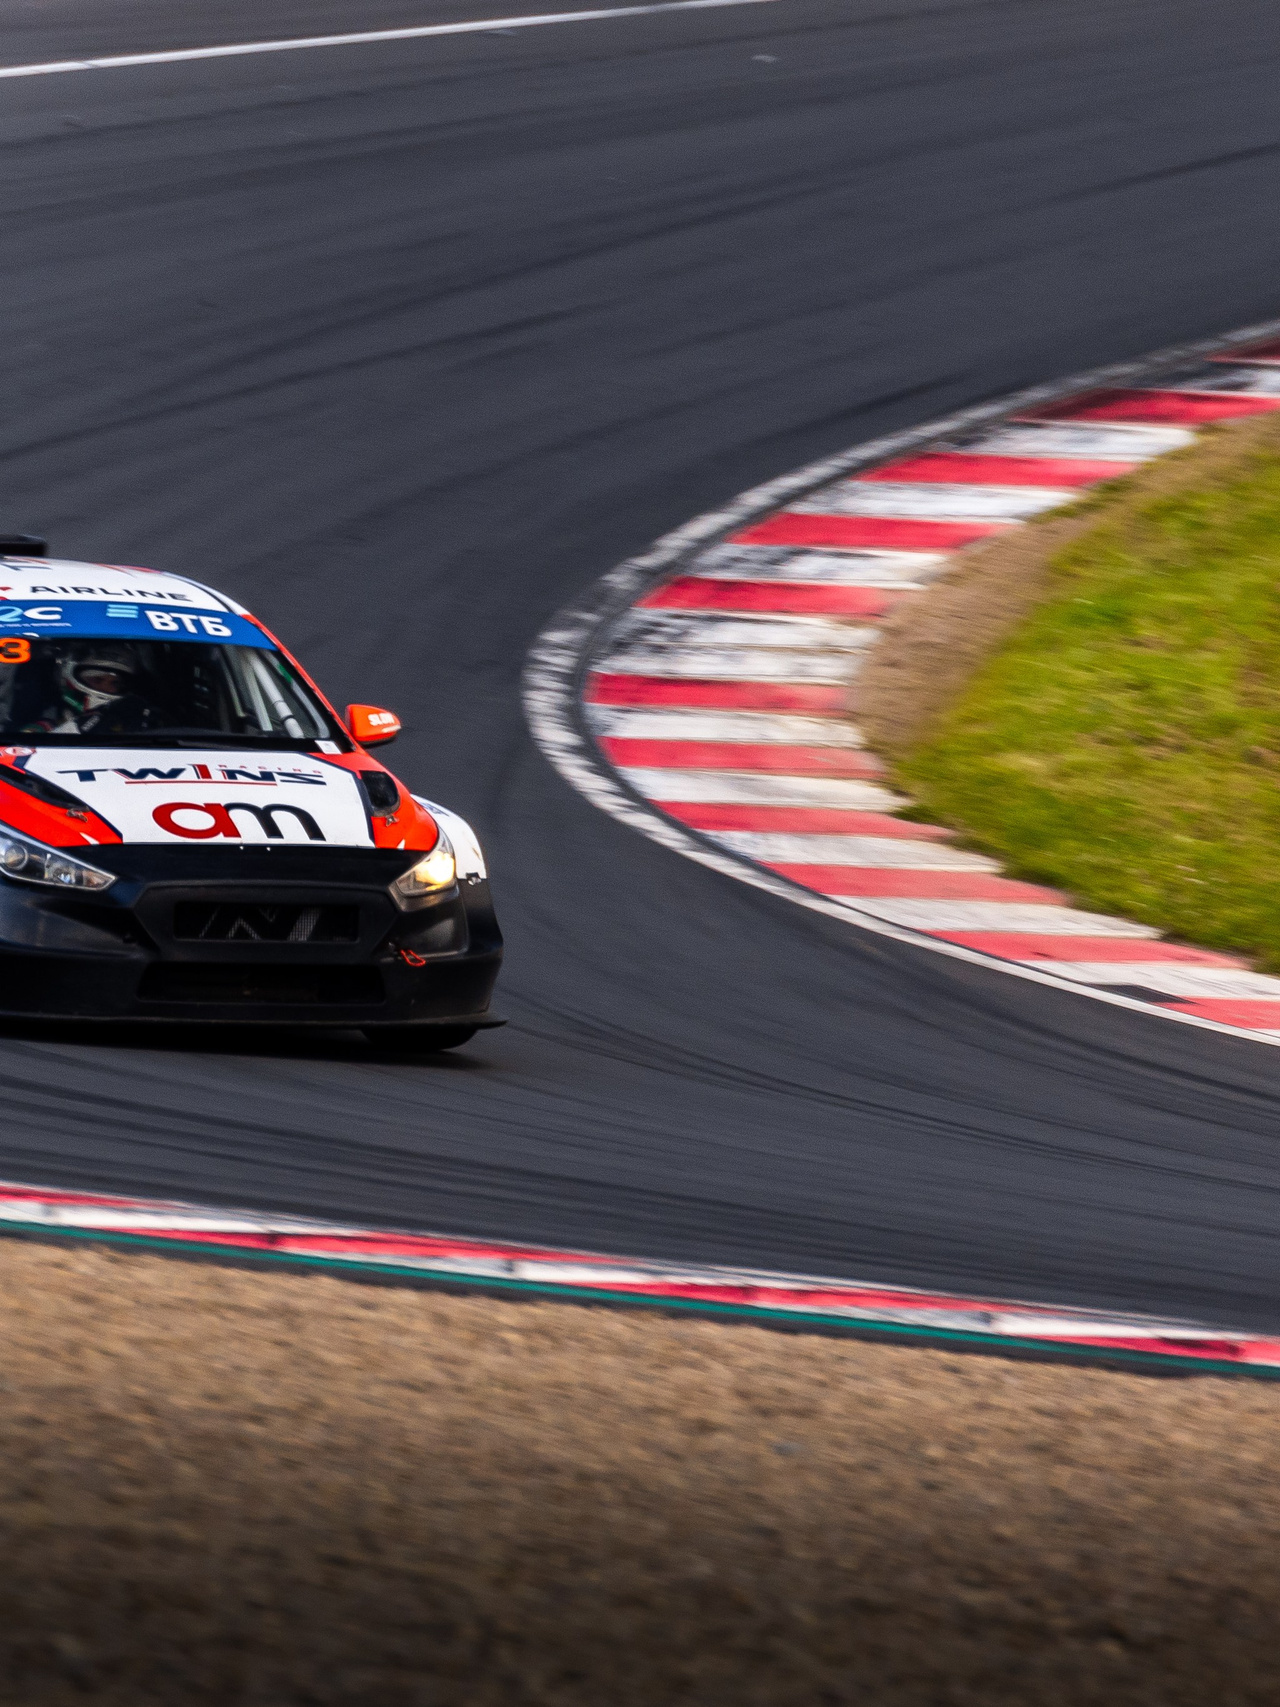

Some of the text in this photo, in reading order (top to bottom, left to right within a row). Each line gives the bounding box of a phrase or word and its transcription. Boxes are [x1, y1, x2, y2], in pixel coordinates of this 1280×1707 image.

[30, 585, 193, 602] AIRLINE
[144, 610, 232, 637] ВТБ
[55, 763, 327, 787] TWINS
[152, 801, 326, 842] am
